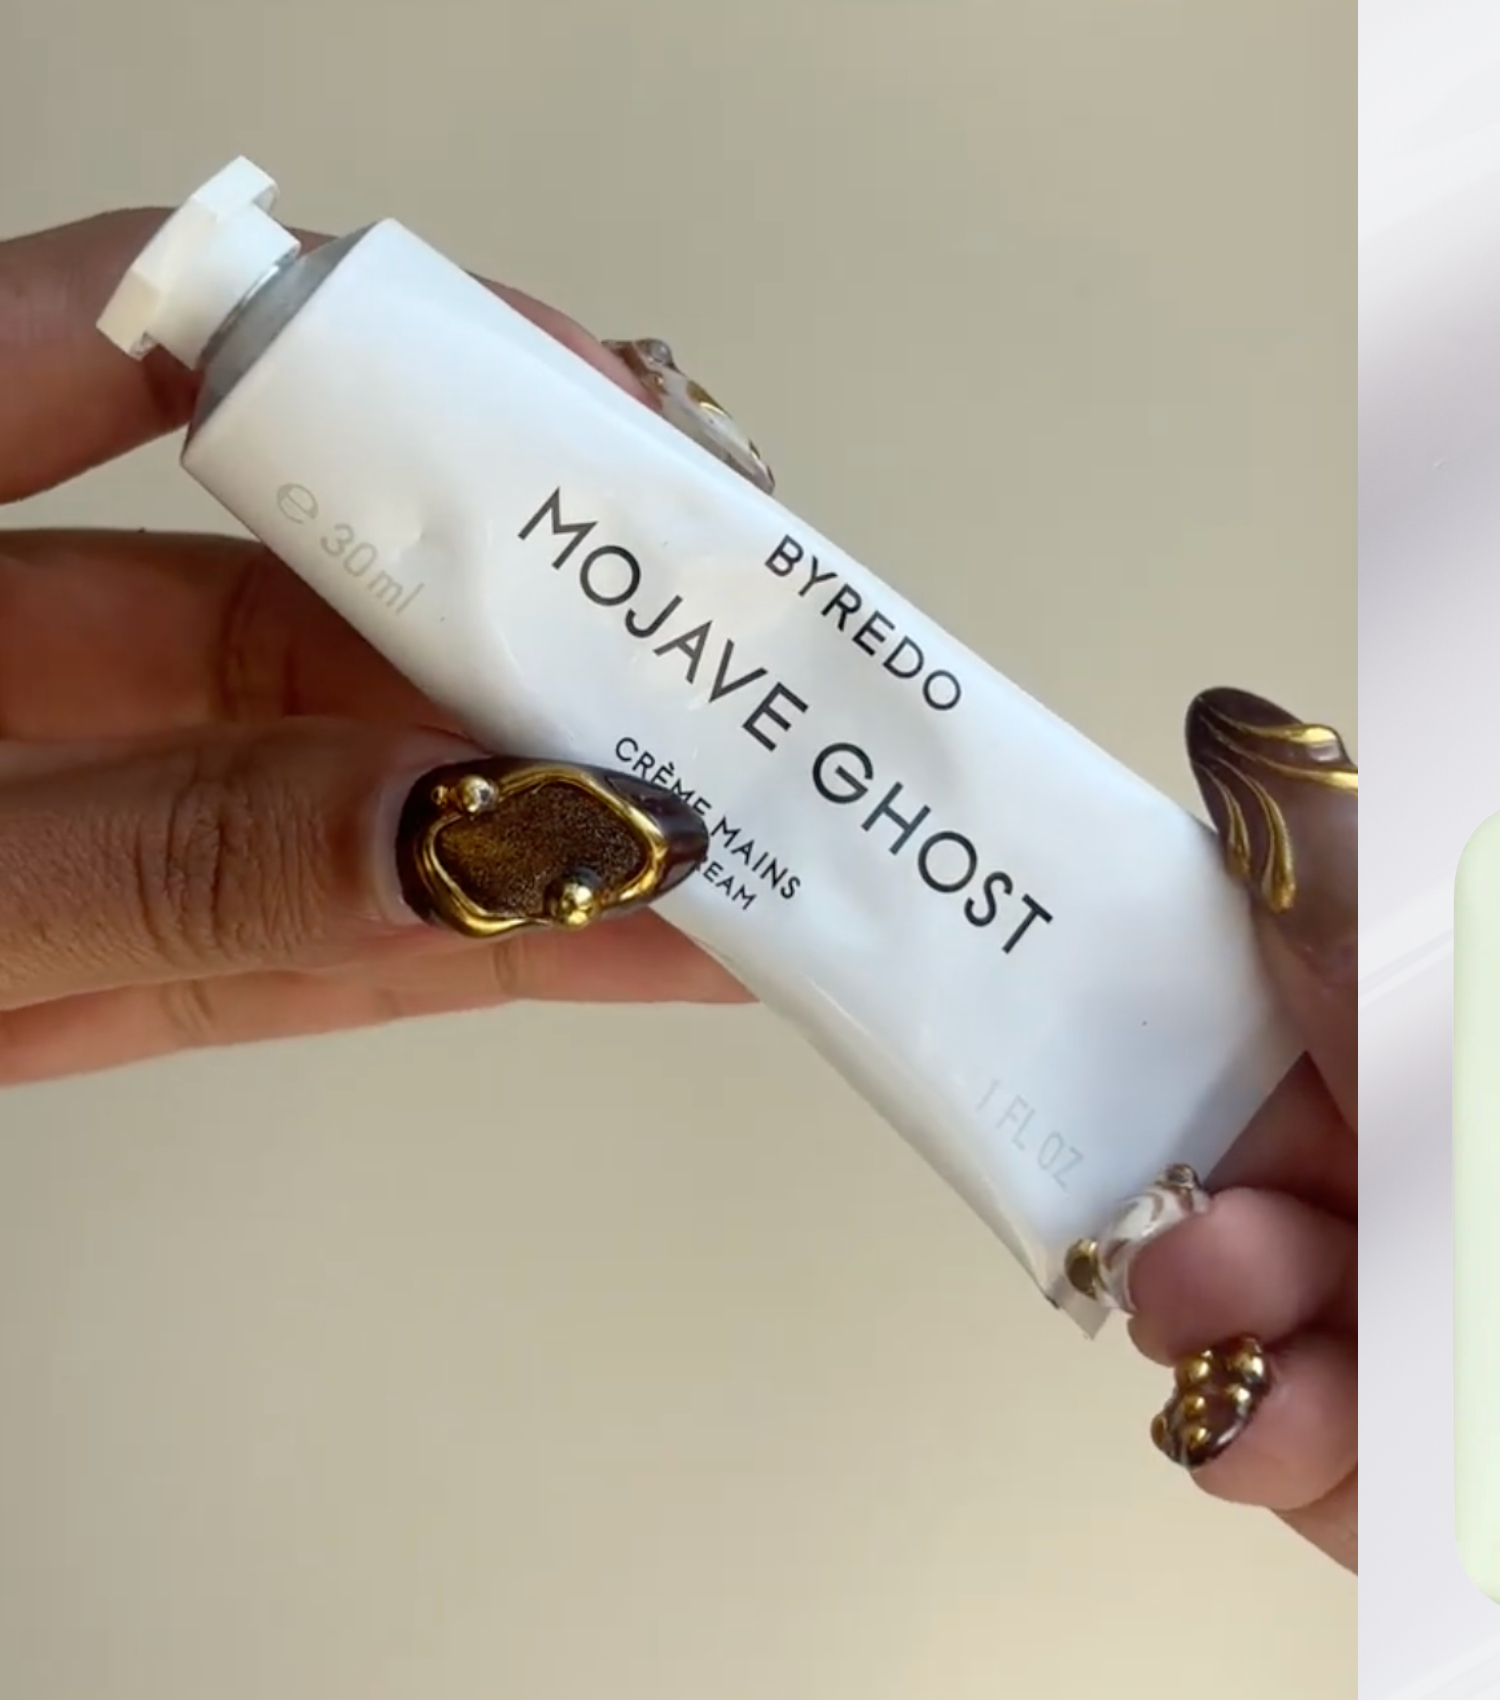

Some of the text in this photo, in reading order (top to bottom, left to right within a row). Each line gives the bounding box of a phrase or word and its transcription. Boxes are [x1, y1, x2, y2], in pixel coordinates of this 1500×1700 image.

[764, 535, 963, 711] BYREDO
[517, 486, 1054, 954] MOJAVE GHOST
[695, 860, 758, 911] EAM
[710, 815, 801, 899] MAINS
[996, 1094, 1037, 1151] FL
[1037, 1131, 1084, 1194] OZ
